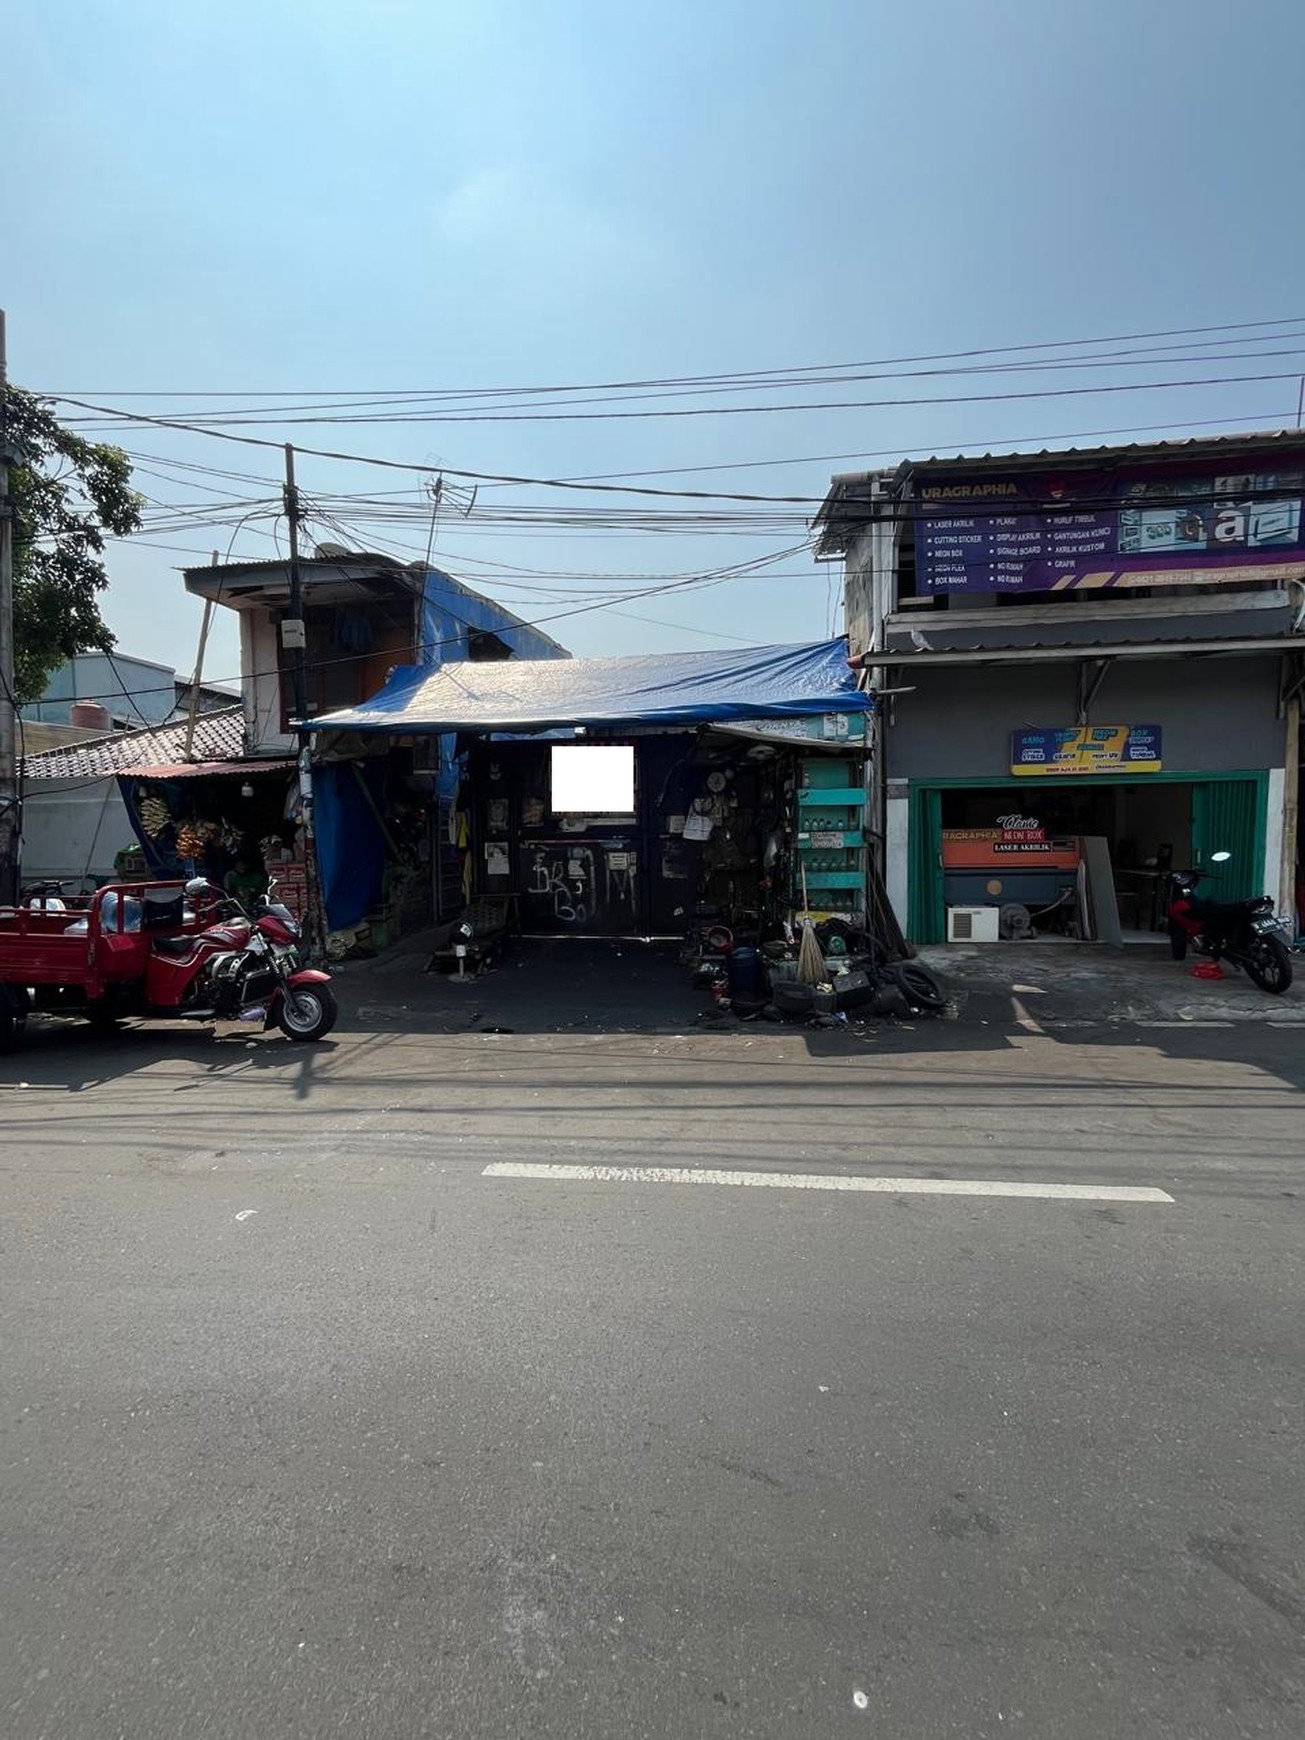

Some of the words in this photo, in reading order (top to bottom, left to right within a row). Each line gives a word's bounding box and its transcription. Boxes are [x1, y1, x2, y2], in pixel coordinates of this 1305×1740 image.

[921, 483, 1017, 499] URAGRAPHIA
[933, 520, 952, 529] LASER
[934, 535, 957, 545] CUTTING
[958, 535, 982, 543] STICKER
[1053, 531, 1089, 541] GANTUNGAN
[934, 550, 951, 558] NEON
[952, 549, 964, 558] BOX
[1019, 545, 1041, 556] BOARD
[934, 576, 949, 586] BOX
[1003, 830, 1025, 841] NEON
[1026, 829, 1043, 840] BOX
[993, 843, 1020, 852] LASER
[1020, 843, 1050, 851] AKRILIK
